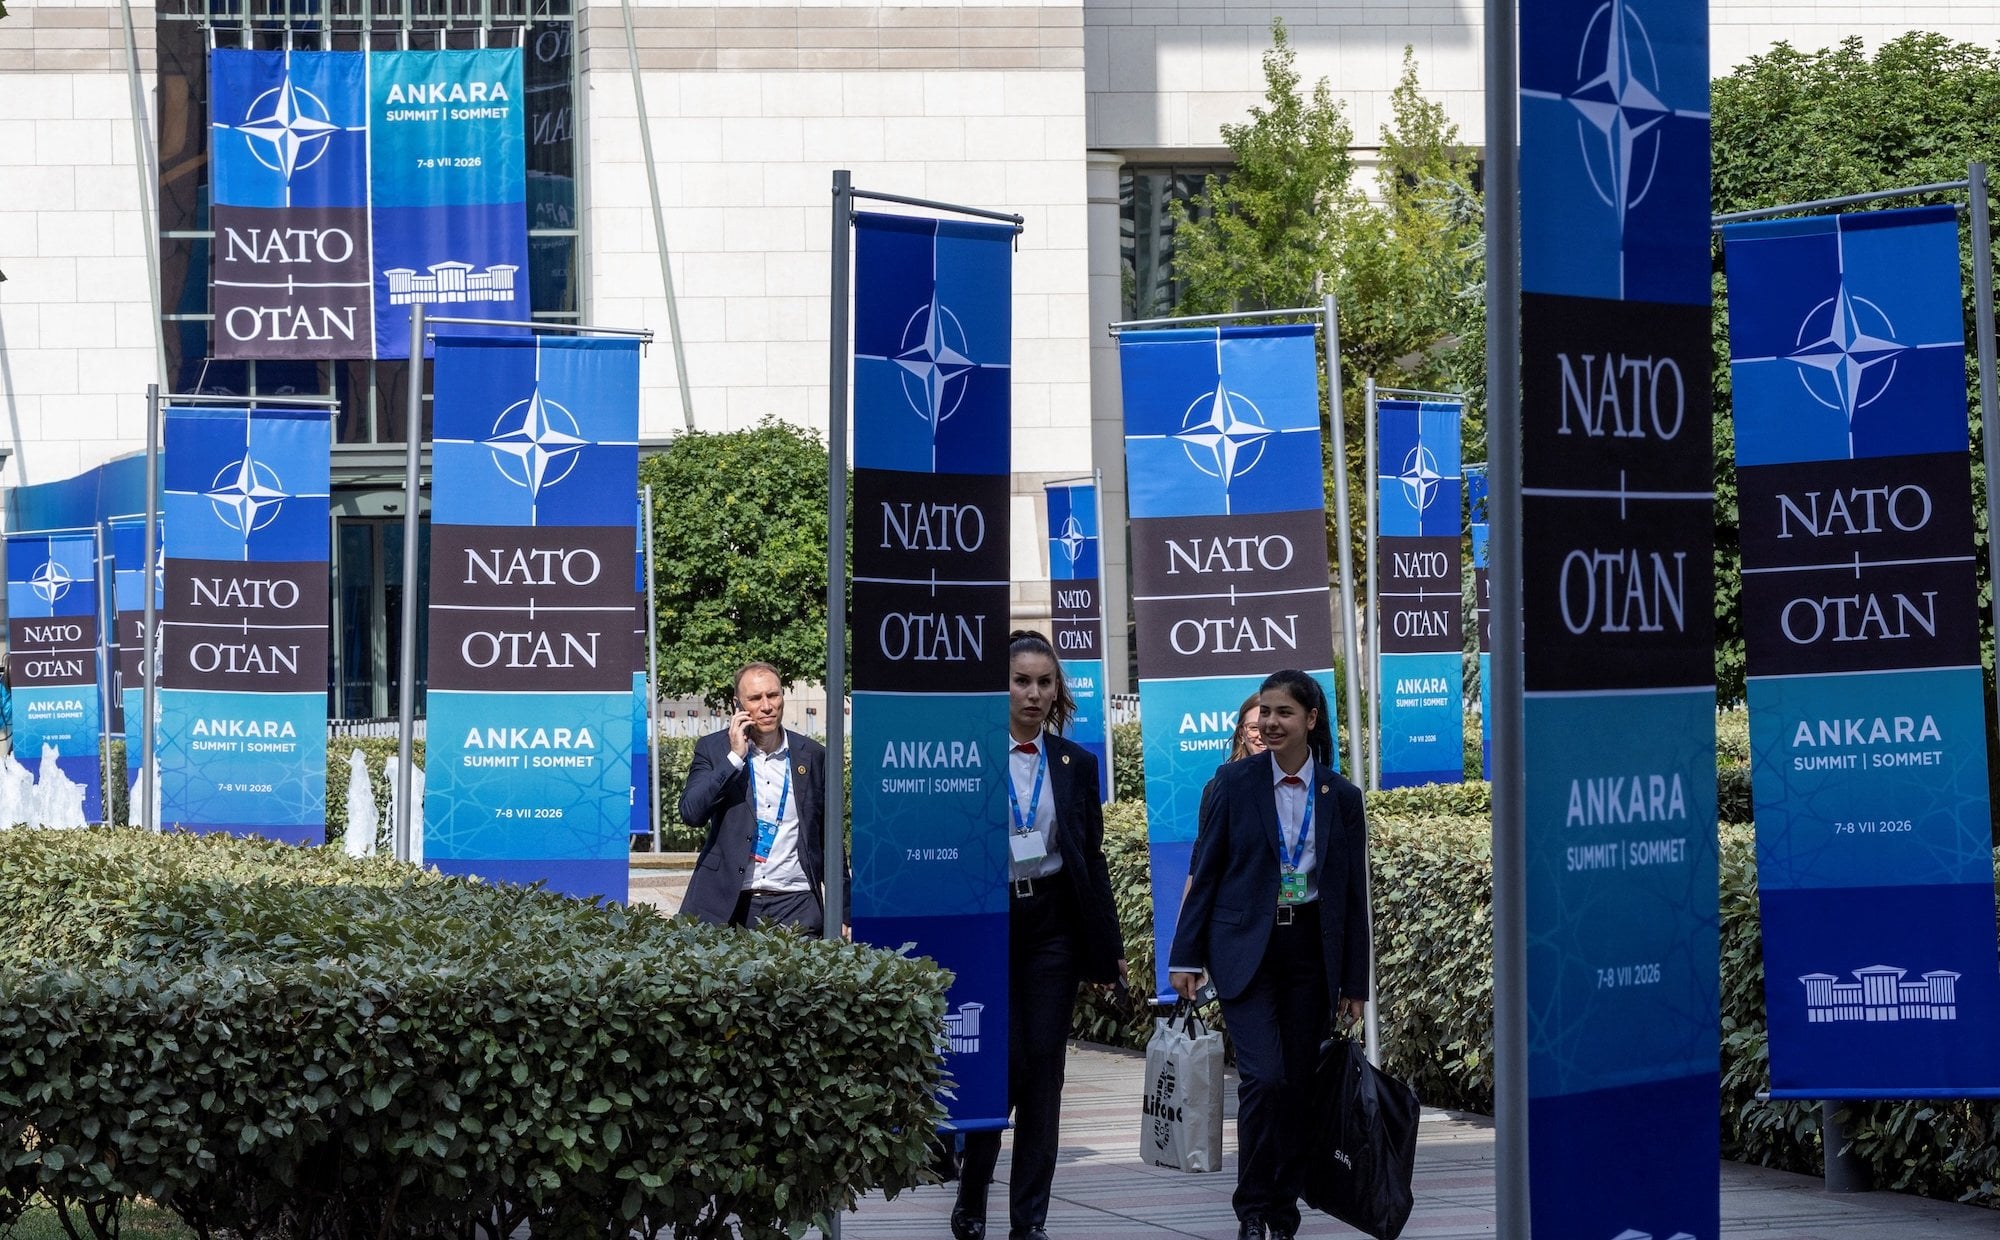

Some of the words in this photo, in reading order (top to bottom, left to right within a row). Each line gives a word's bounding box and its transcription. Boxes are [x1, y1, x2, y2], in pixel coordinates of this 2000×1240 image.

[387, 81, 508, 104] ANKARA
[387, 109, 439, 121] SUMMIT
[451, 107, 509, 120] SOMMET
[417, 159, 434, 168] 7-8
[437, 158, 451, 167] VII
[455, 157, 481, 167] 2026
[225, 228, 353, 263] NATO
[226, 306, 357, 341] OTAN
[1557, 353, 1684, 440] NATO
[1776, 485, 1931, 538] NATO
[880, 502, 984, 552] NATO
[1165, 535, 1293, 574] NATO
[1394, 552, 1447, 578] NATO
[464, 548, 600, 585] NATO
[191, 578, 299, 608] NATO
[1058, 590, 1091, 608] NATO
[1560, 549, 1686, 634] OTAN
[1394, 611, 1448, 637] OTAN
[1781, 592, 1938, 644] OTAN
[24, 625, 81, 642] NATO
[880, 612, 985, 661] OTAN
[1059, 631, 1092, 649] OTAN
[1171, 615, 1298, 654] OTAN
[190, 643, 300, 674] OTAN
[462, 631, 600, 668] OTAN
[25, 660, 83, 677] OTAN
[1396, 678, 1447, 694] ANKARA
[28, 700, 82, 711] ANKARA
[1396, 699, 1419, 707] SUMMIT
[1423, 698, 1447, 706] SOMMET
[192, 719, 296, 737] ANKARA
[1179, 711, 1238, 733] ANK
[1793, 715, 1941, 747] ANKARA
[192, 741, 237, 750] SUMMIT
[248, 743, 296, 752] SOMMET
[464, 728, 594, 748] ANKARA
[1180, 739, 1233, 751] SUMMIT
[464, 756, 519, 767] SUMMIT
[533, 756, 594, 767] SOMMET
[882, 741, 981, 768] ANKARA
[1794, 755, 1857, 770] SUMMIT
[1873, 751, 1942, 767] SOMMET
[249, 784, 272, 792] 2026
[882, 779, 925, 792] SUMMIT
[935, 778, 981, 792] SOMMET
[1567, 773, 1685, 826] ANKARA
[496, 809, 512, 818] 7-8
[516, 809, 531, 818] VII
[534, 809, 562, 818] 2026
[1835, 823, 1855, 834] 7-8
[1858, 822, 1875, 832] VII
[1880, 820, 1911, 832] 2026
[907, 849, 920, 860] 7-8
[923, 849, 934, 860] VII
[937, 848, 958, 860] 2026
[1567, 844, 1617, 871] SUMMIT
[1630, 838, 1685, 865] SOMMET
[1597, 968, 1614, 988] 7-8
[1617, 967, 1631, 986] VII
[1634, 963, 1660, 984] 2026
